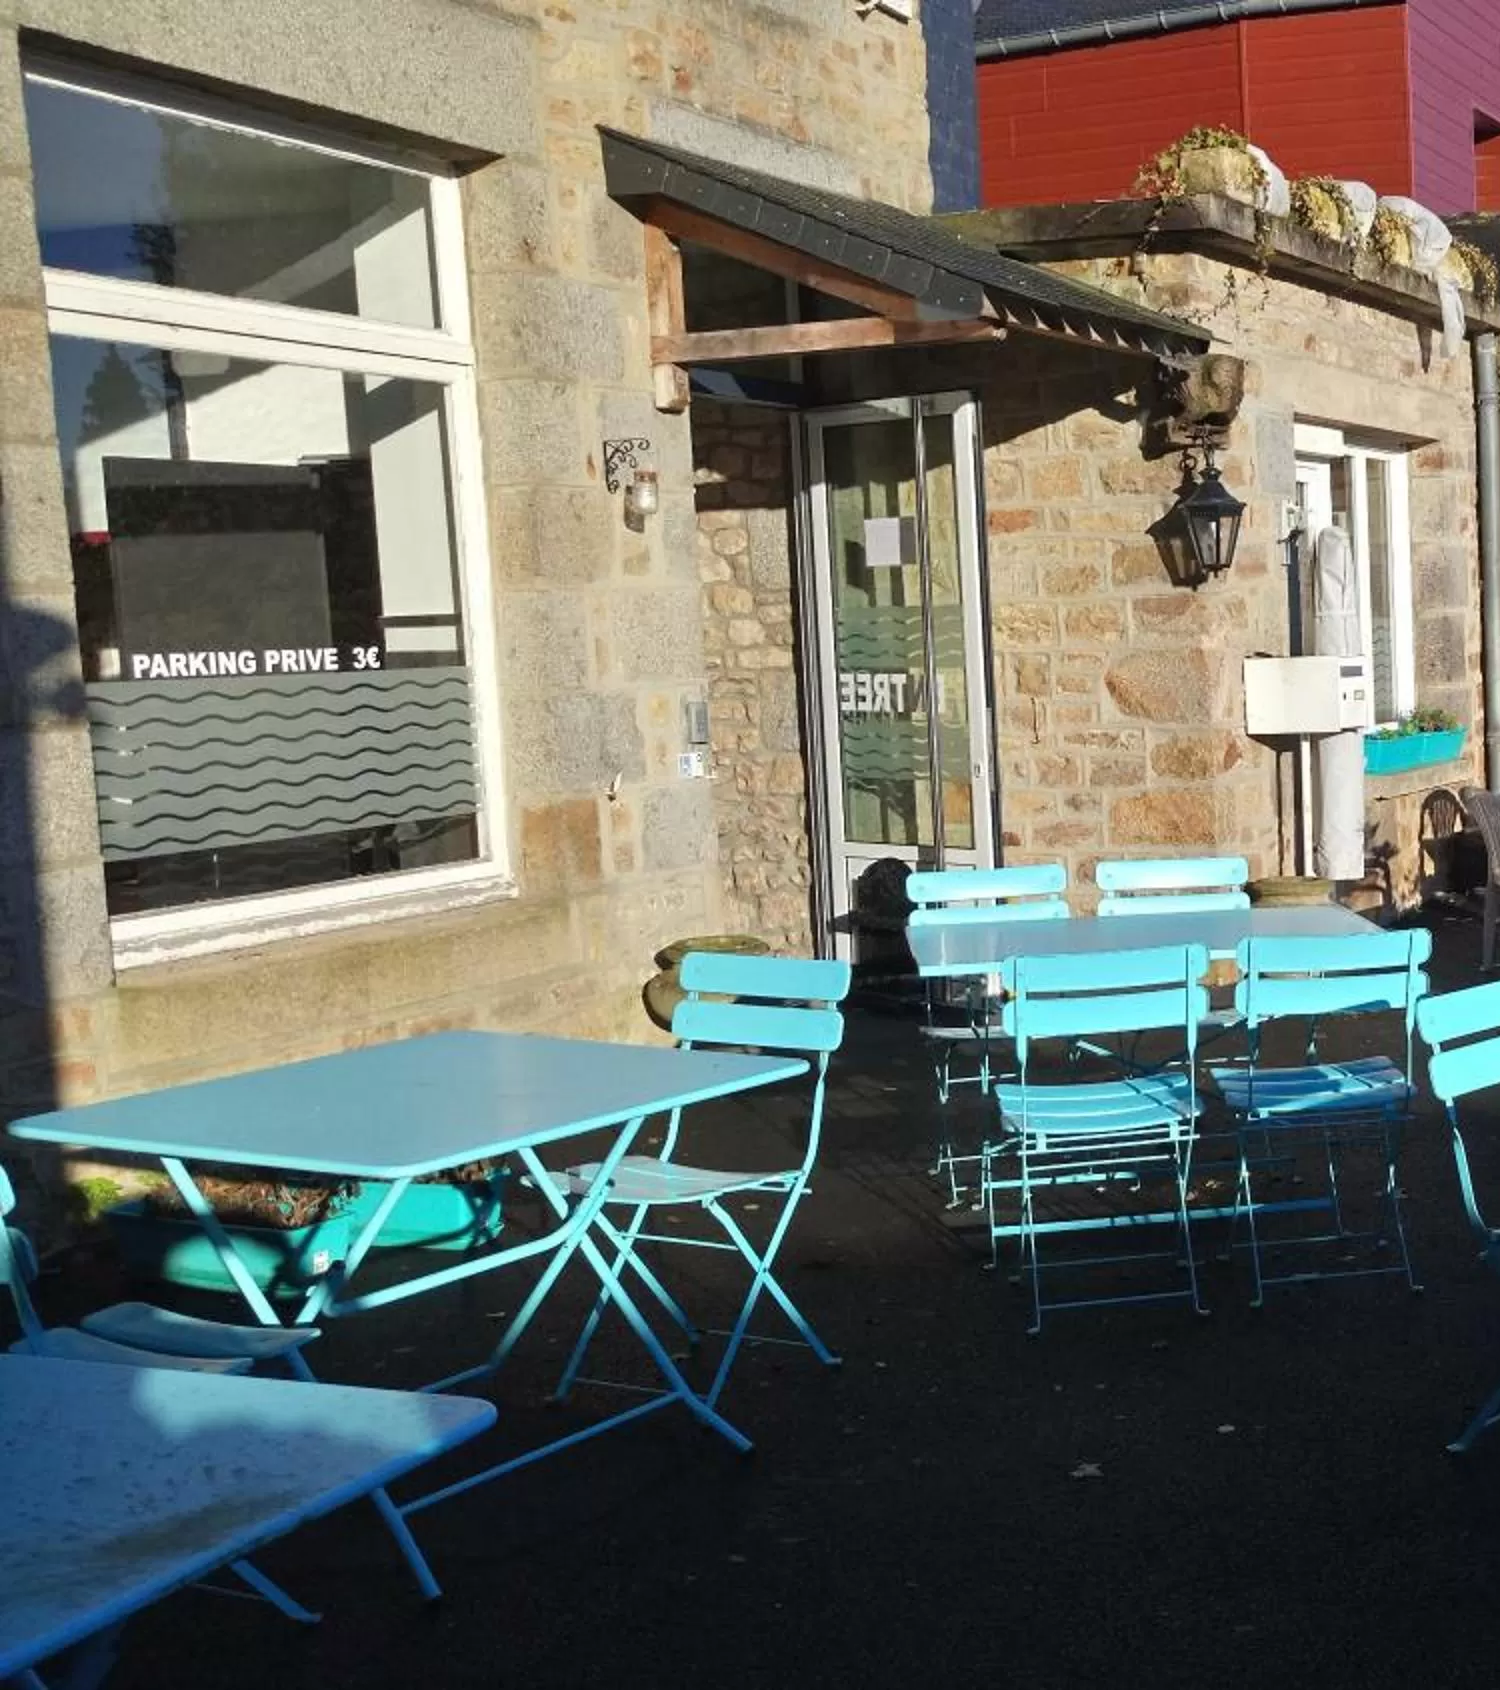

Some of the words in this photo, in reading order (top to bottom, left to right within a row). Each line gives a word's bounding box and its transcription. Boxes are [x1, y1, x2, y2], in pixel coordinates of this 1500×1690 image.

[132, 651, 256, 678] PARKING
[264, 647, 339, 672] PRIVE
[352, 646, 380, 669] 3€
